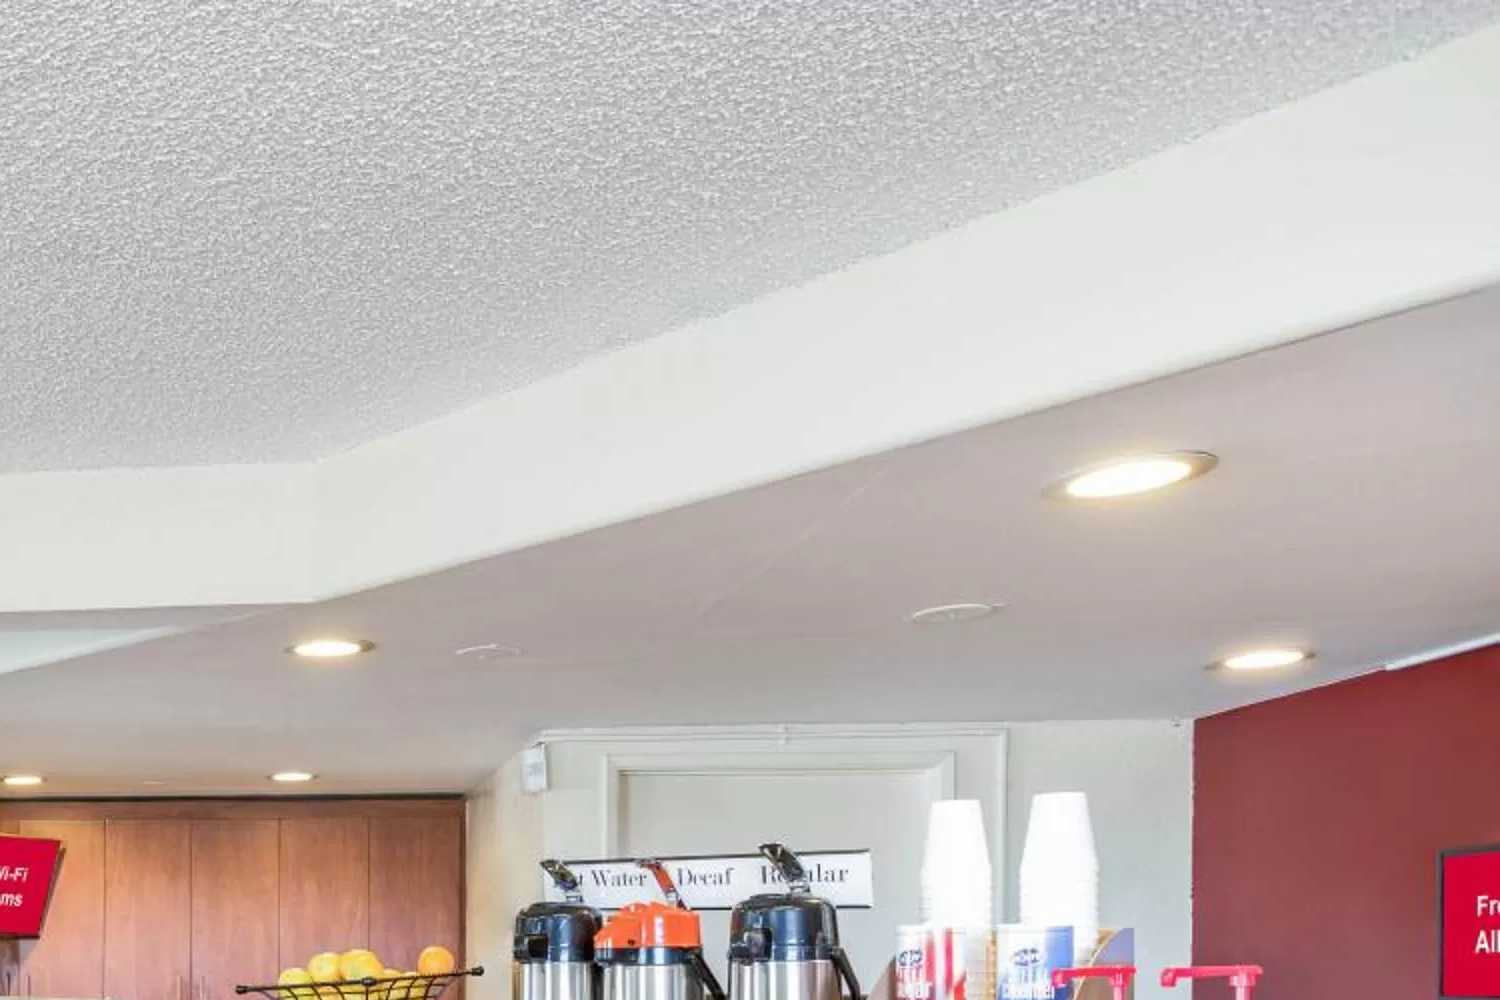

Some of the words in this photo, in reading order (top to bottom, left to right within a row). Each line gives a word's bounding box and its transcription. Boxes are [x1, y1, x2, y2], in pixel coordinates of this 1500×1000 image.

[591, 867, 648, 888] Water
[677, 865, 735, 887] Decaf
[760, 862, 851, 886] Relar
[1476, 894, 1500, 918] Fr
